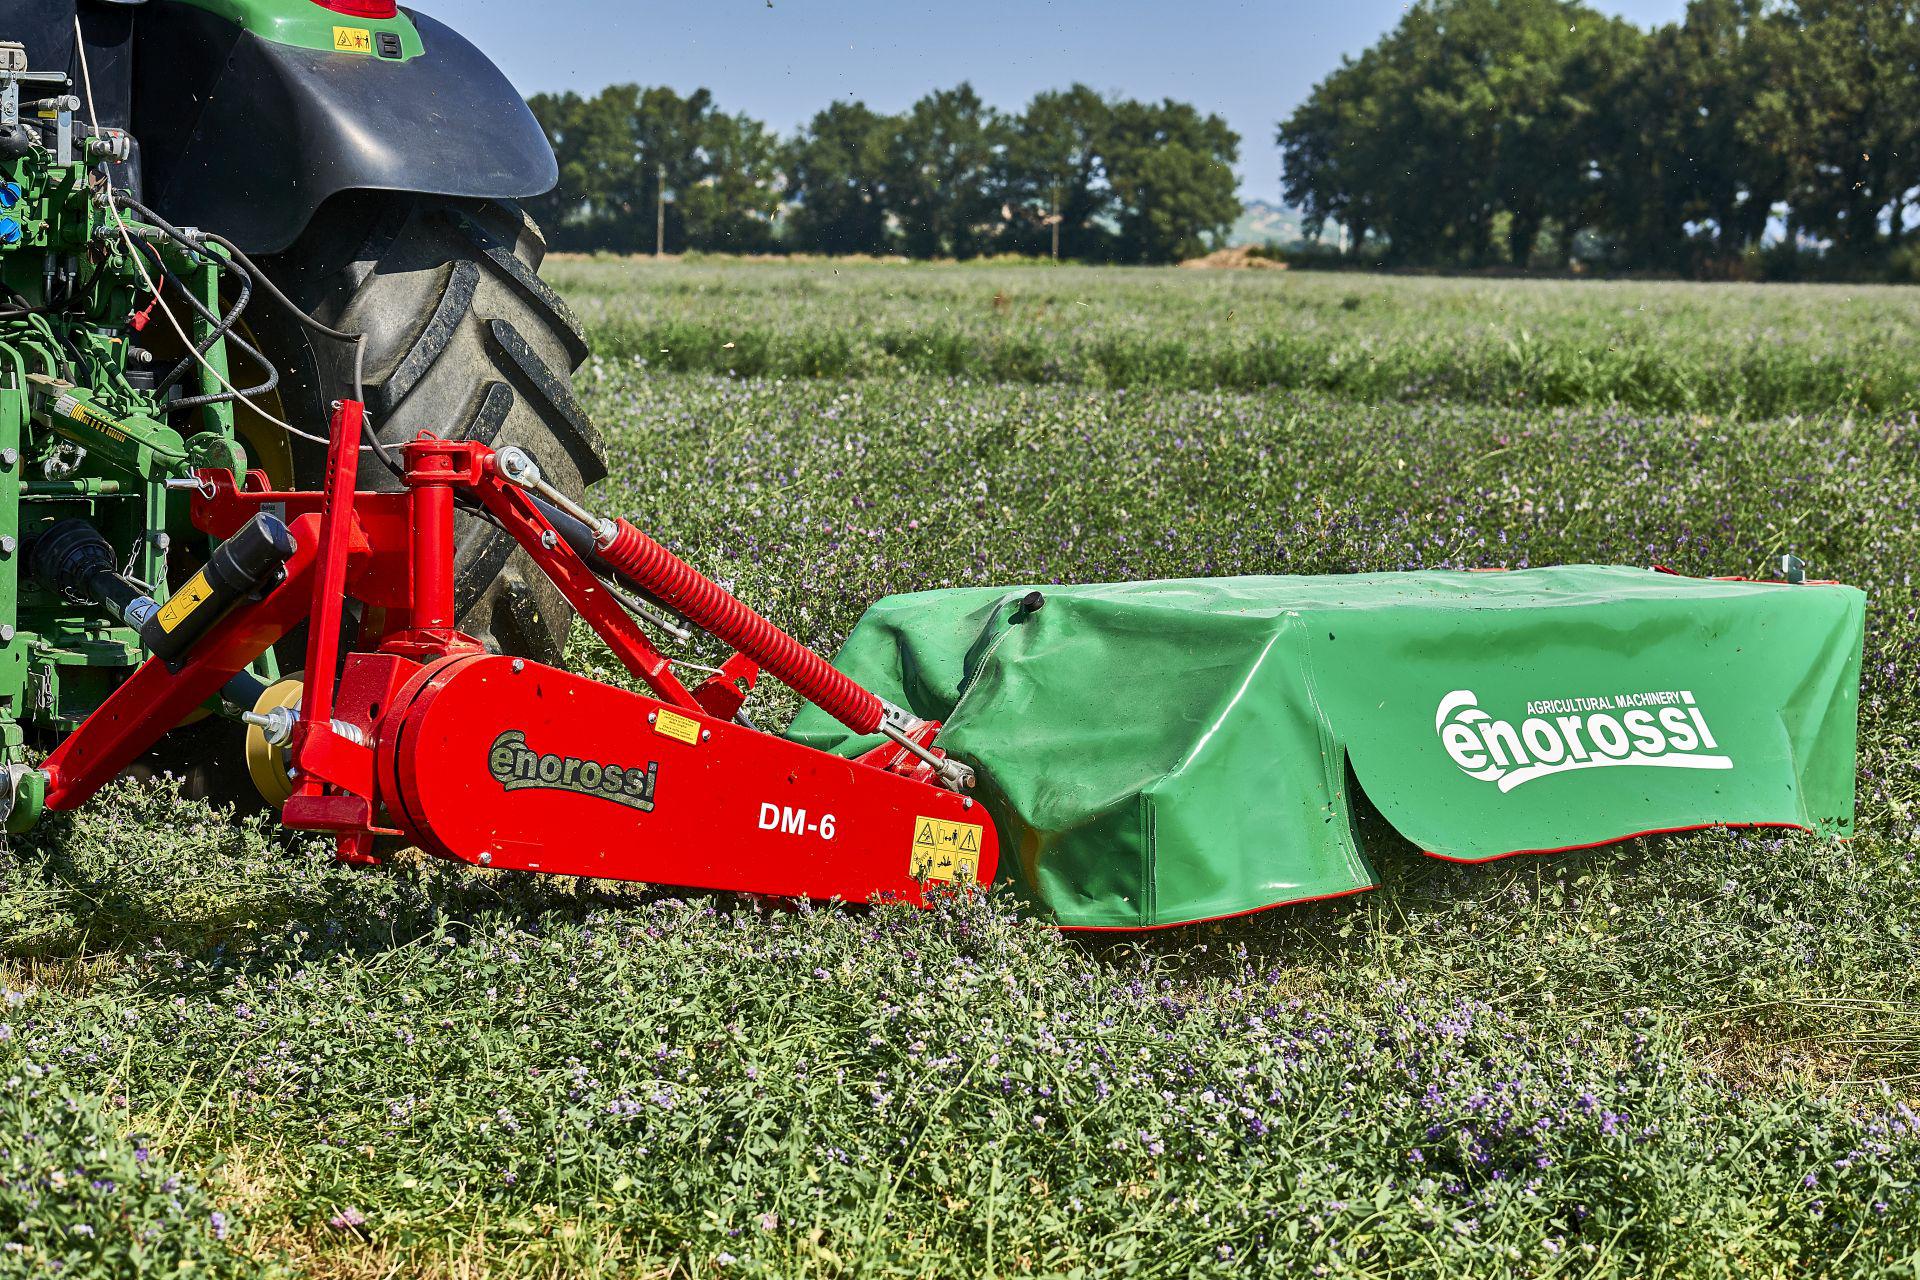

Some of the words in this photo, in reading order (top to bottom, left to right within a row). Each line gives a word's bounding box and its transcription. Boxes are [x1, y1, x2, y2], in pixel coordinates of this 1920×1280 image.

[1526, 697, 1616, 715] AGRICULTURAL
[1614, 691, 1681, 710] MACHINERY
[1440, 691, 1719, 770] enorossi
[489, 743, 658, 803] enorossi
[758, 802, 836, 840] DM-6
